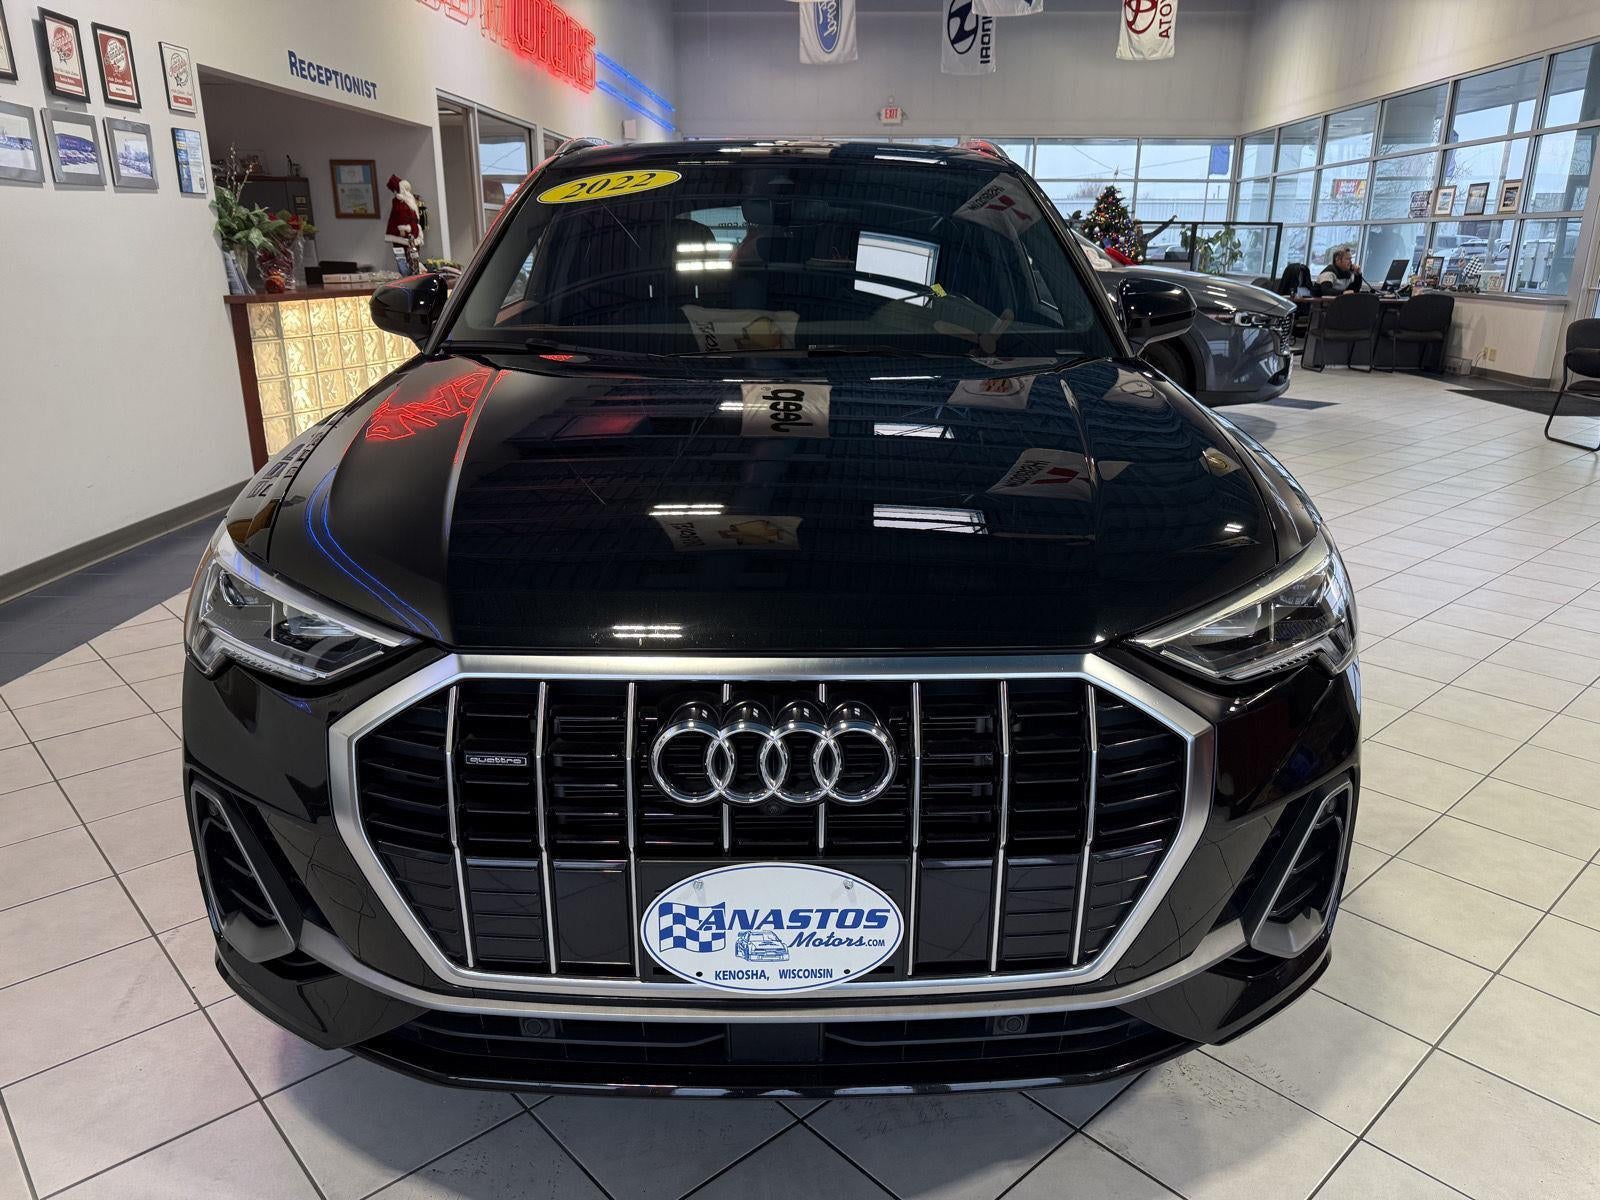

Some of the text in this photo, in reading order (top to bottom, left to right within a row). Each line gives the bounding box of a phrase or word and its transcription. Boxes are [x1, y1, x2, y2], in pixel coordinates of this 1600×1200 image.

[884, 108, 898, 120] EXIT
[560, 172, 657, 200] 2022
[469, 756, 522, 764] quattro
[697, 908, 891, 931] ANASTOS
[714, 968, 833, 981] KENOSHA, WISCONSIN
